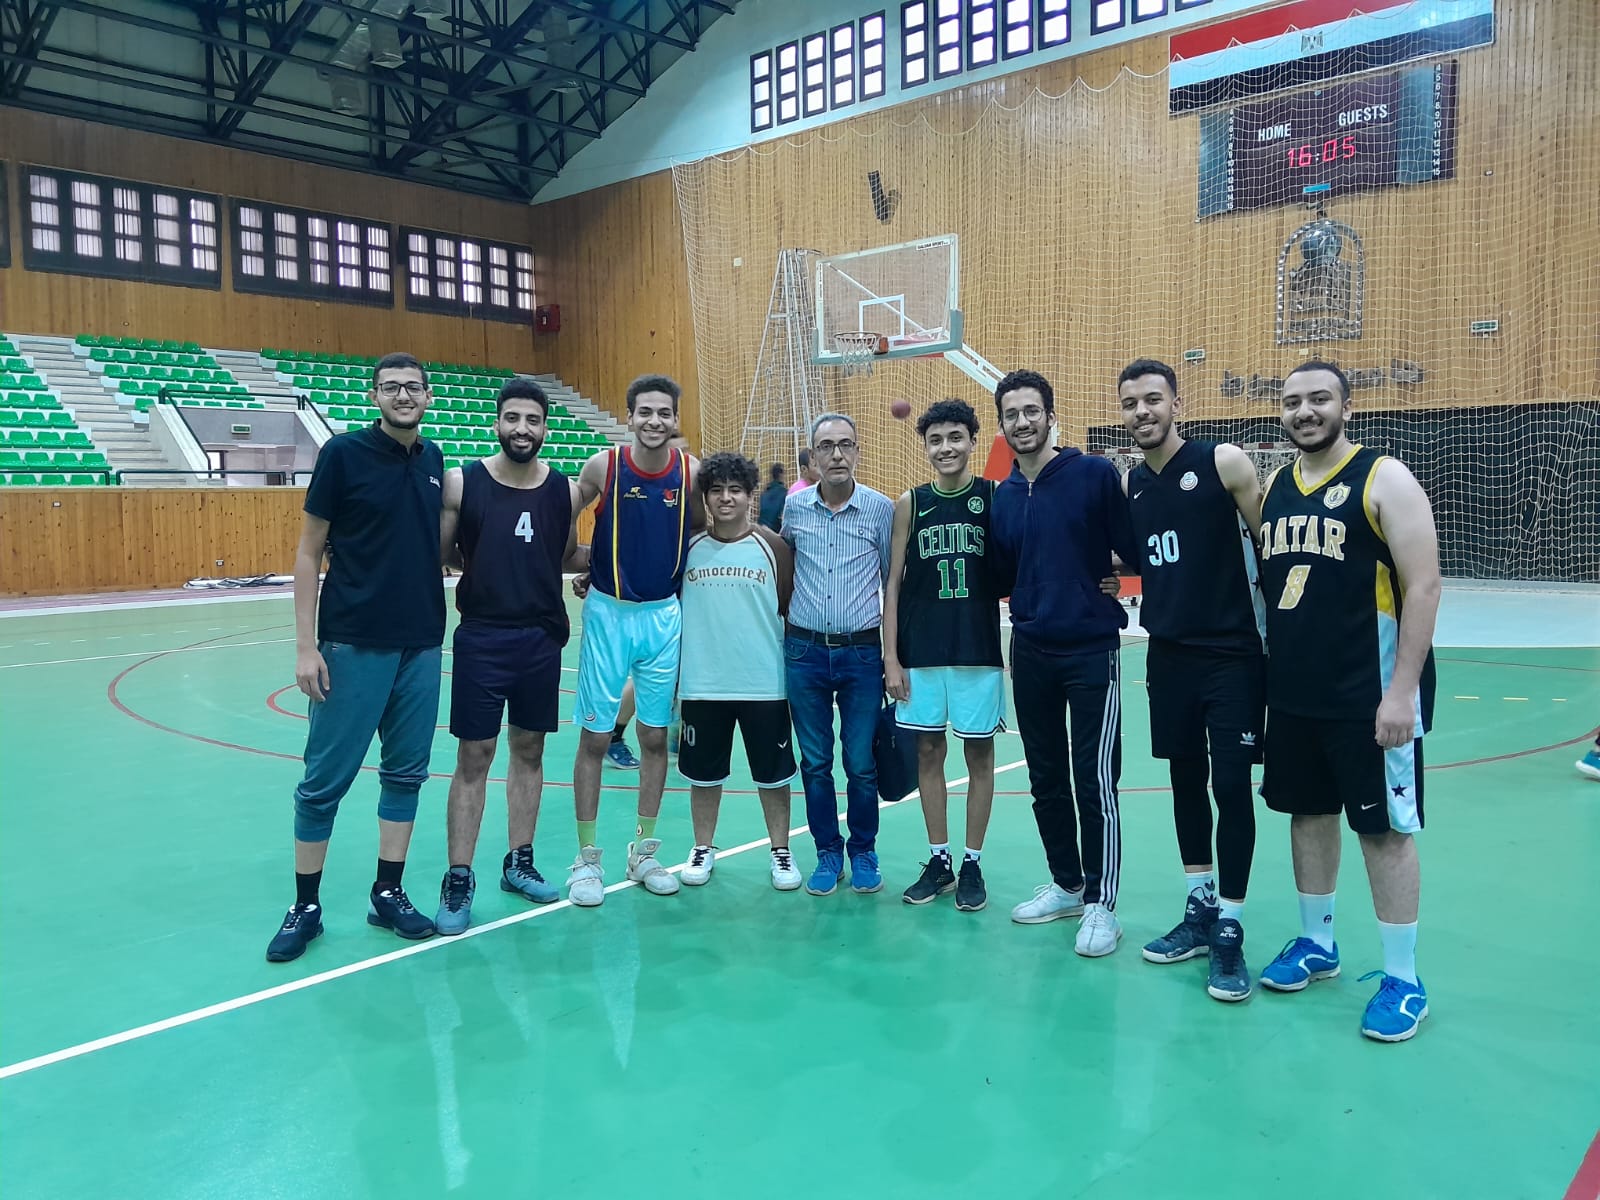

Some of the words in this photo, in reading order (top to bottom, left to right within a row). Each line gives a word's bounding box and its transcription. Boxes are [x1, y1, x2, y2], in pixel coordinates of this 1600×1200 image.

[1436, 63, 1441, 71] 4
[1339, 104, 1388, 126] GUESTS
[1435, 111, 1440, 119] 9
[1258, 123, 1291, 141] HOME
[1434, 130, 1441, 138] 11
[1287, 136, 1355, 168] 16:05
[1433, 168, 1441, 176] 15
[514, 511, 535, 543] 4
[918, 523, 984, 559] CELTICS
[1147, 529, 1180, 566] 30
[937, 558, 969, 599] 11
